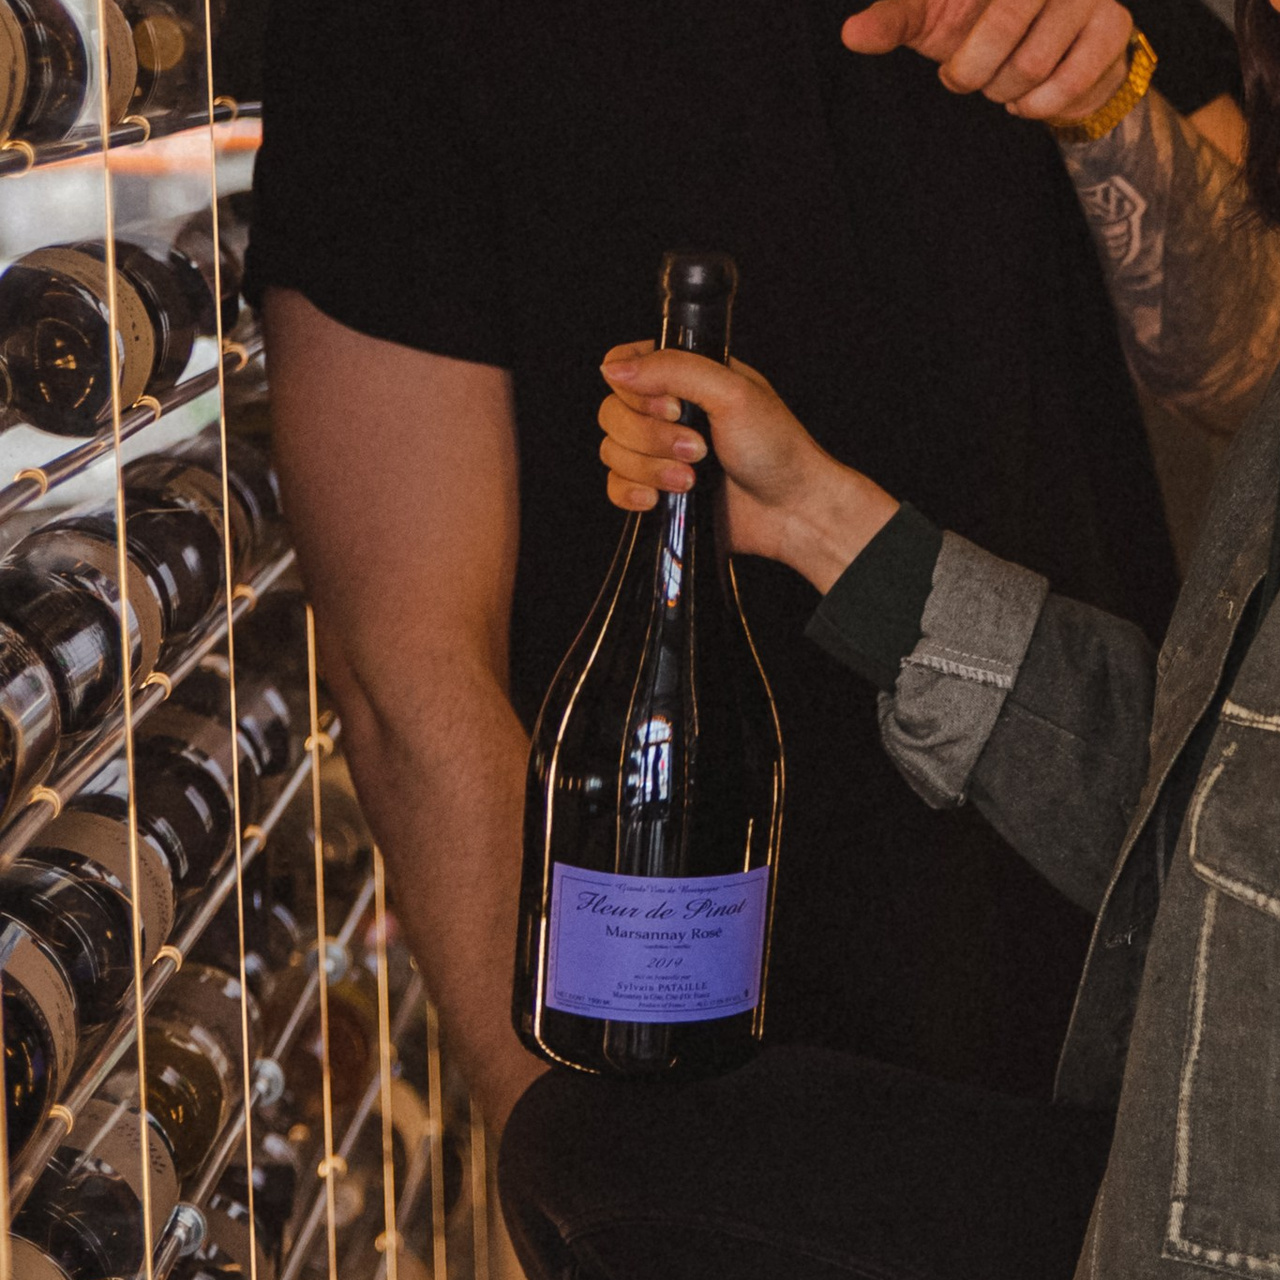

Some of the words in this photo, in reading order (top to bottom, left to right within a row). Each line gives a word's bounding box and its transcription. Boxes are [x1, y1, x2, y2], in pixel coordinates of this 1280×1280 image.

[576, 891, 641, 918] Fleur
[644, 900, 677, 919] de
[683, 898, 748, 920] Pinot
[605, 924, 686, 943] Marsannay
[691, 926, 723, 940] Rosé
[647, 957, 684, 969] 2019
[616, 982, 655, 992] Sylvain
[658, 982, 708, 992] PATAILLE
